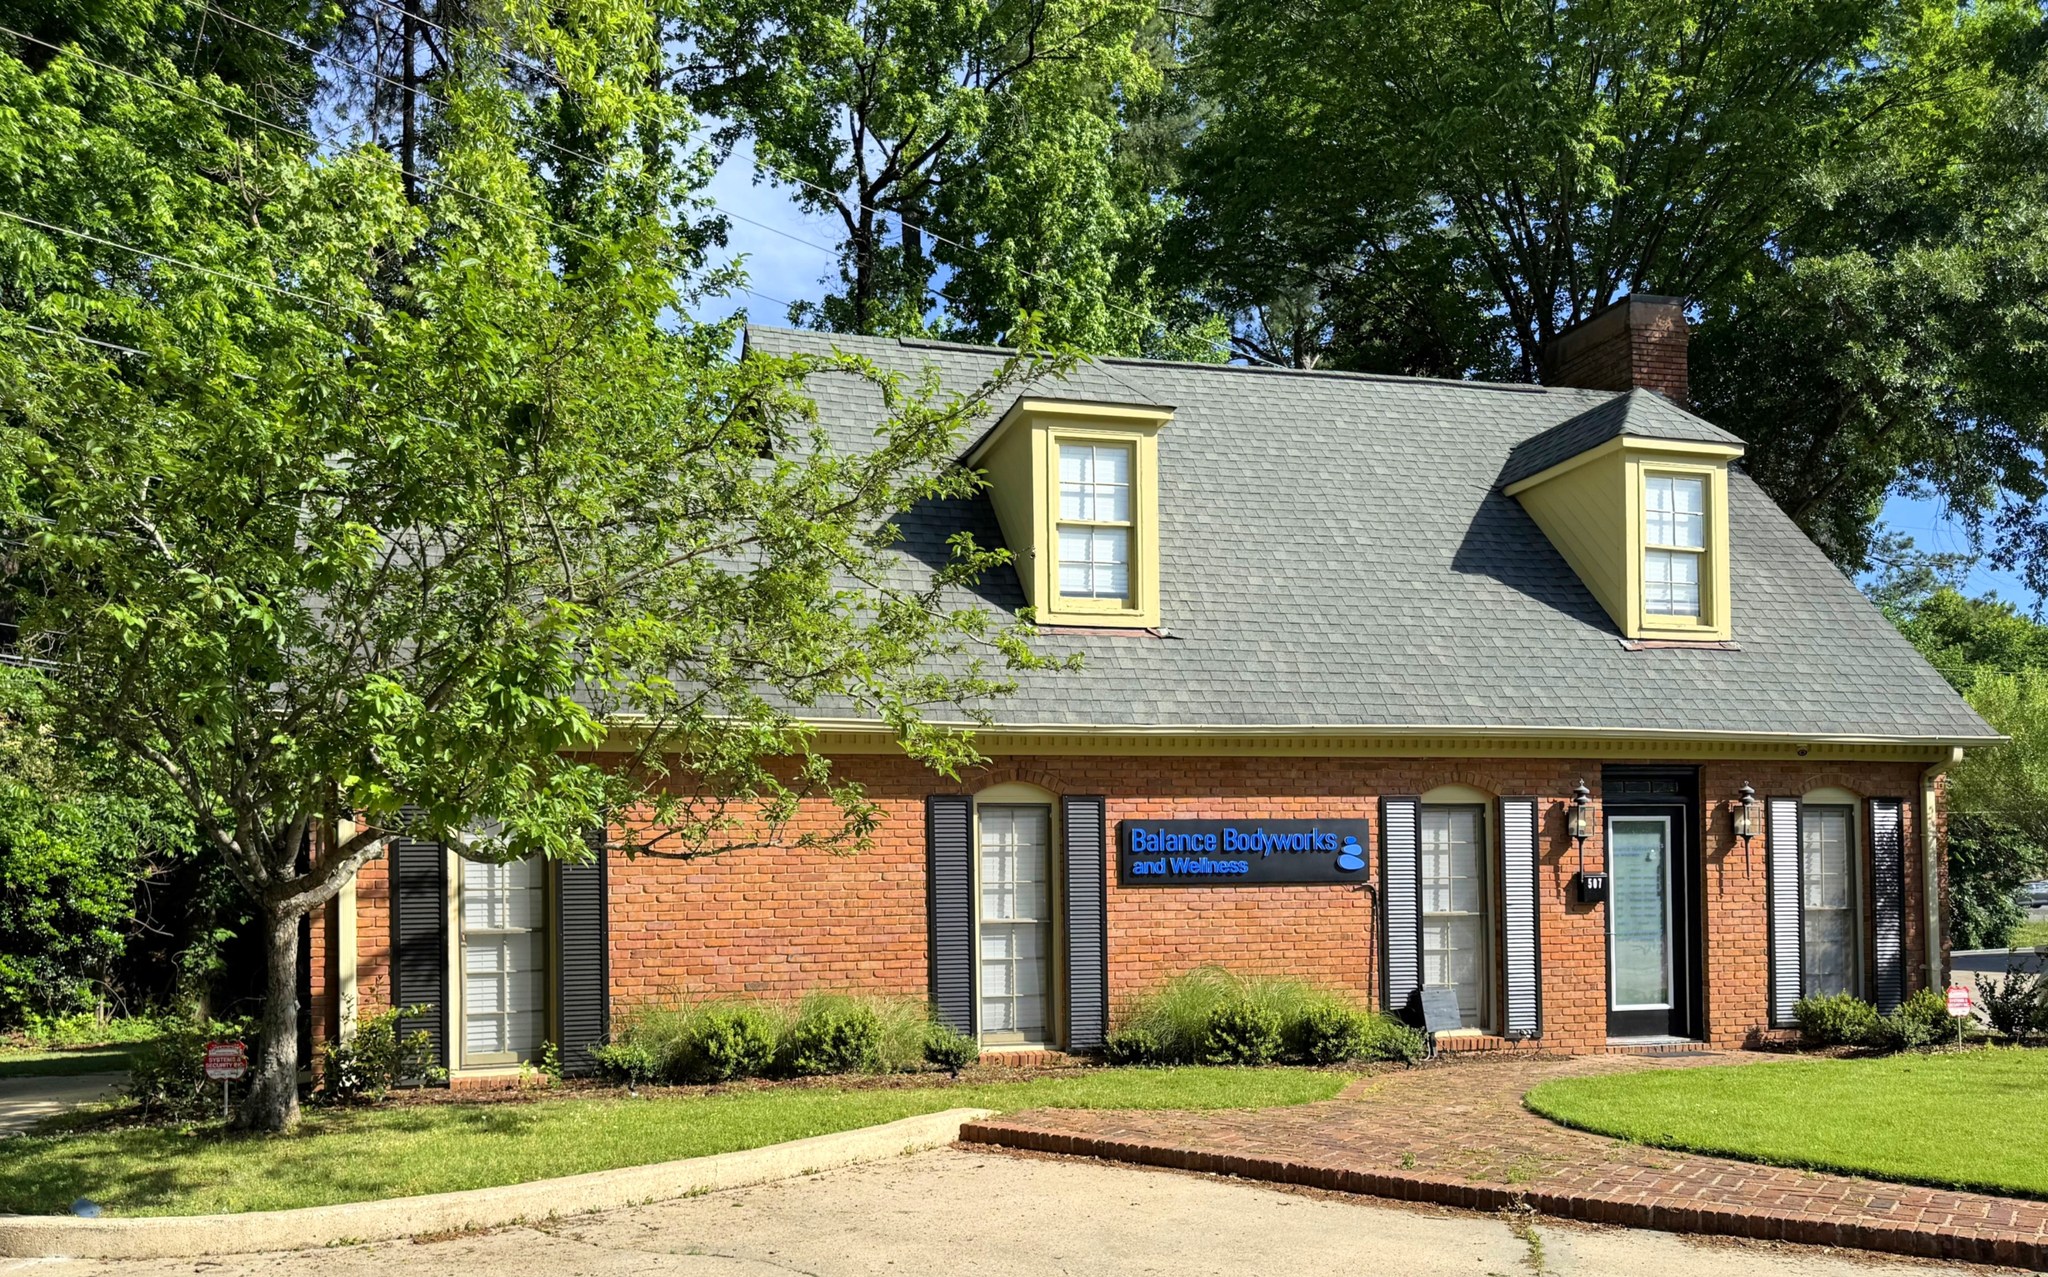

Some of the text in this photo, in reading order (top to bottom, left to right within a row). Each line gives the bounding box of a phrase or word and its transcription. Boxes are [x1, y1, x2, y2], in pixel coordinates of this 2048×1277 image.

[1131, 827, 1338, 857] Balance Bodyworks
[1132, 856, 1249, 875] and Wellness
[1587, 877, 1603, 889] 507
